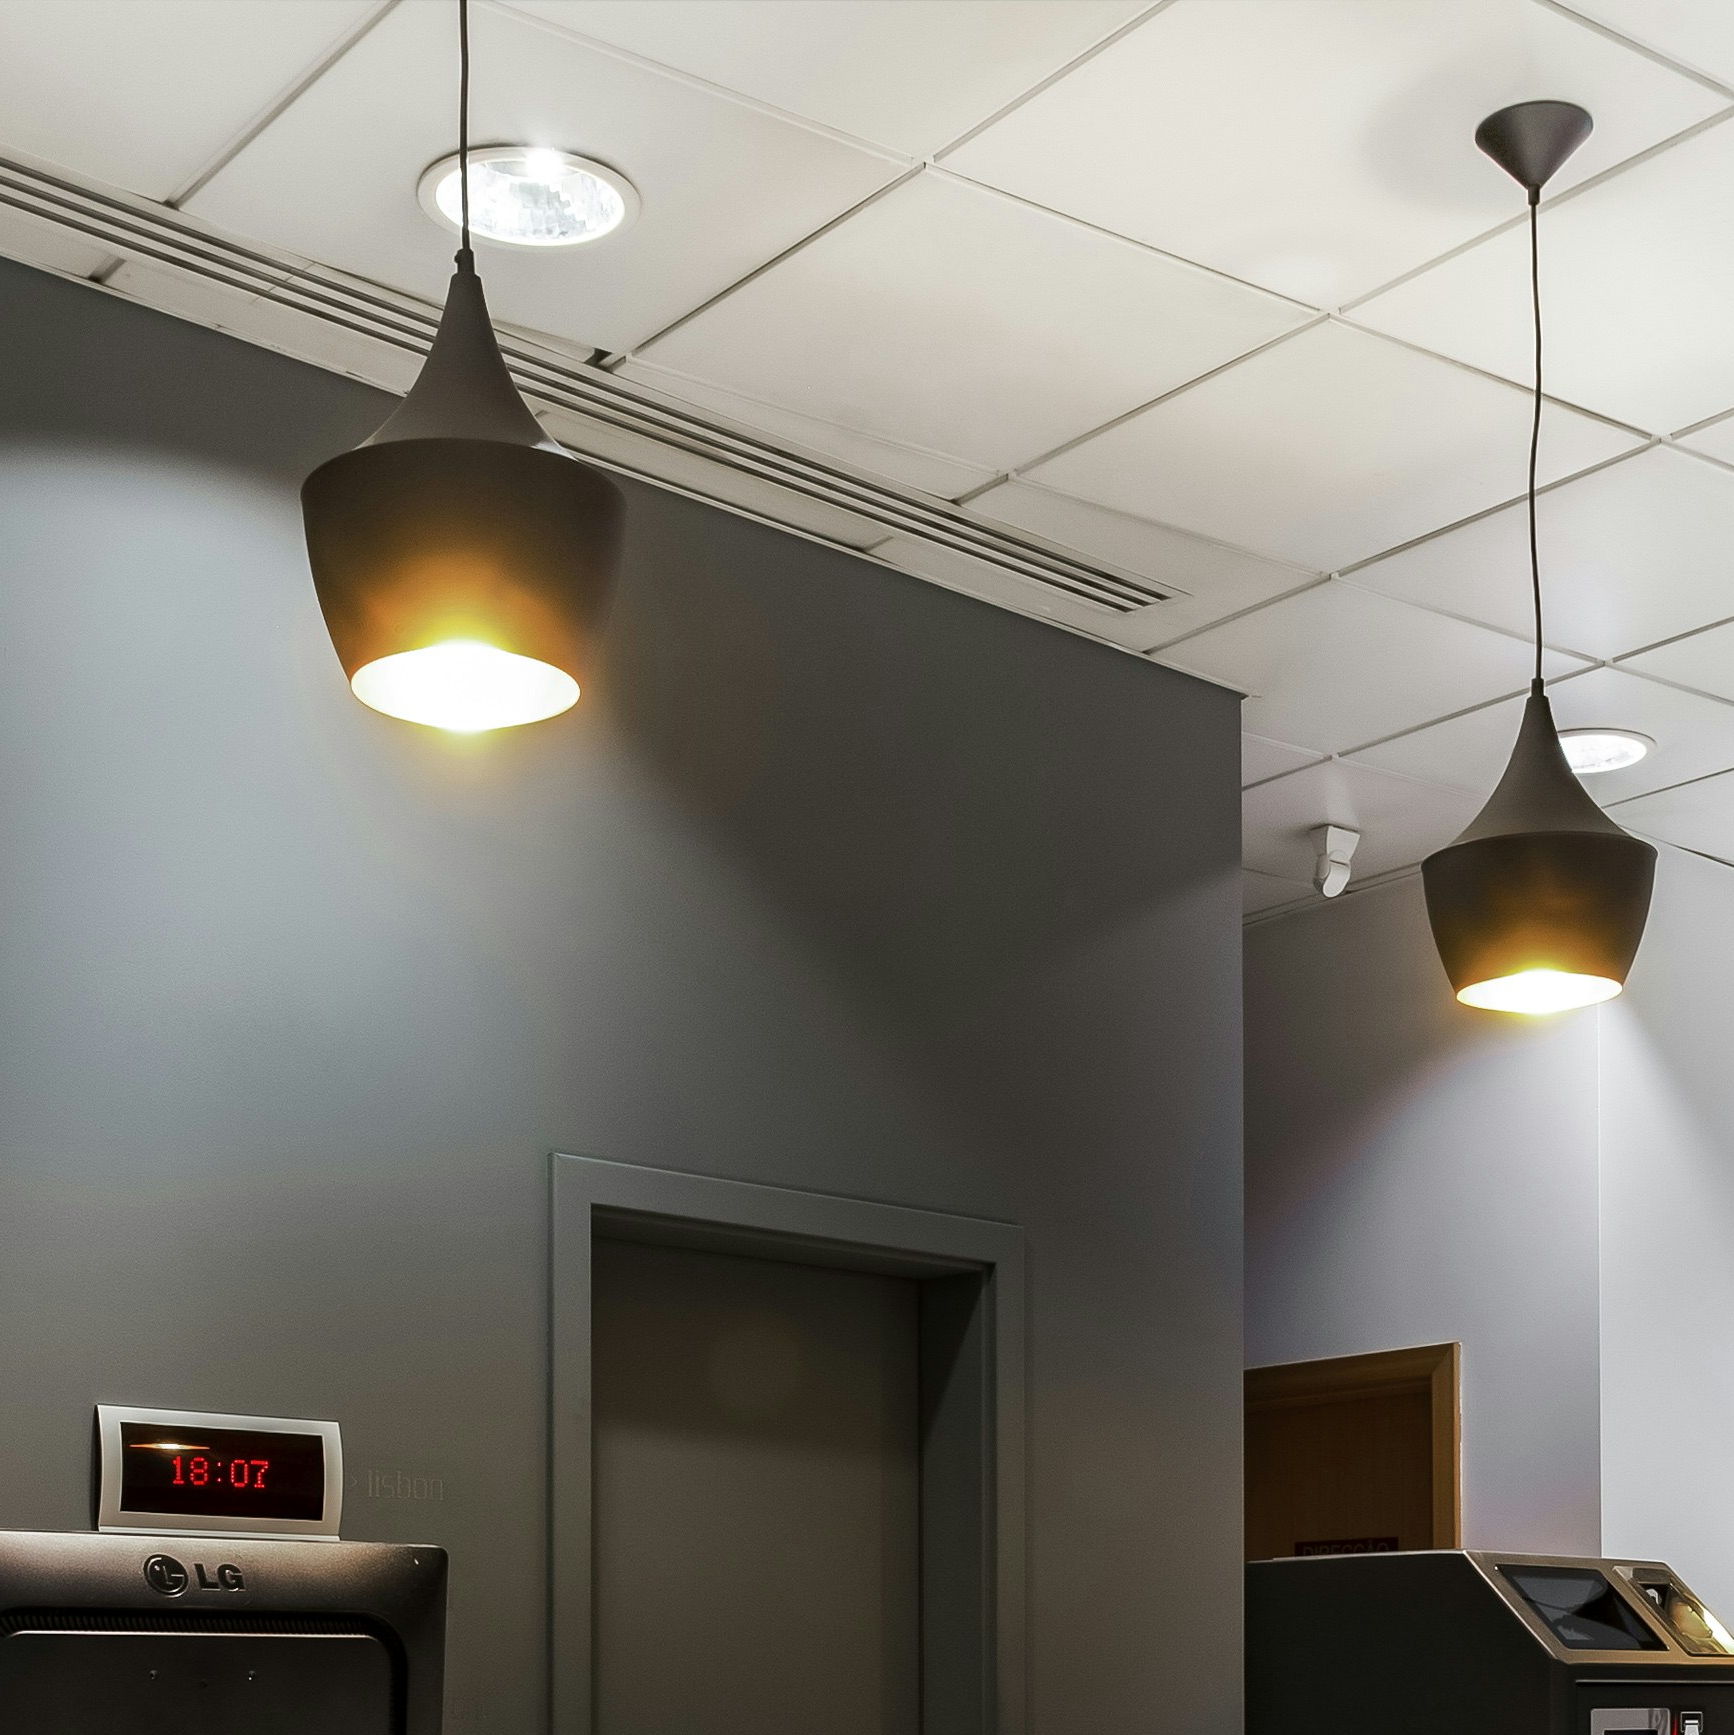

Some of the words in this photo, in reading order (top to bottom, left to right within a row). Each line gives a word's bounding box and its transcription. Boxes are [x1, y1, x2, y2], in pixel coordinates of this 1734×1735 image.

[171, 1455, 270, 1489] 18:07
[367, 1469, 444, 1501] lisbon
[194, 1563, 246, 1592] LG
